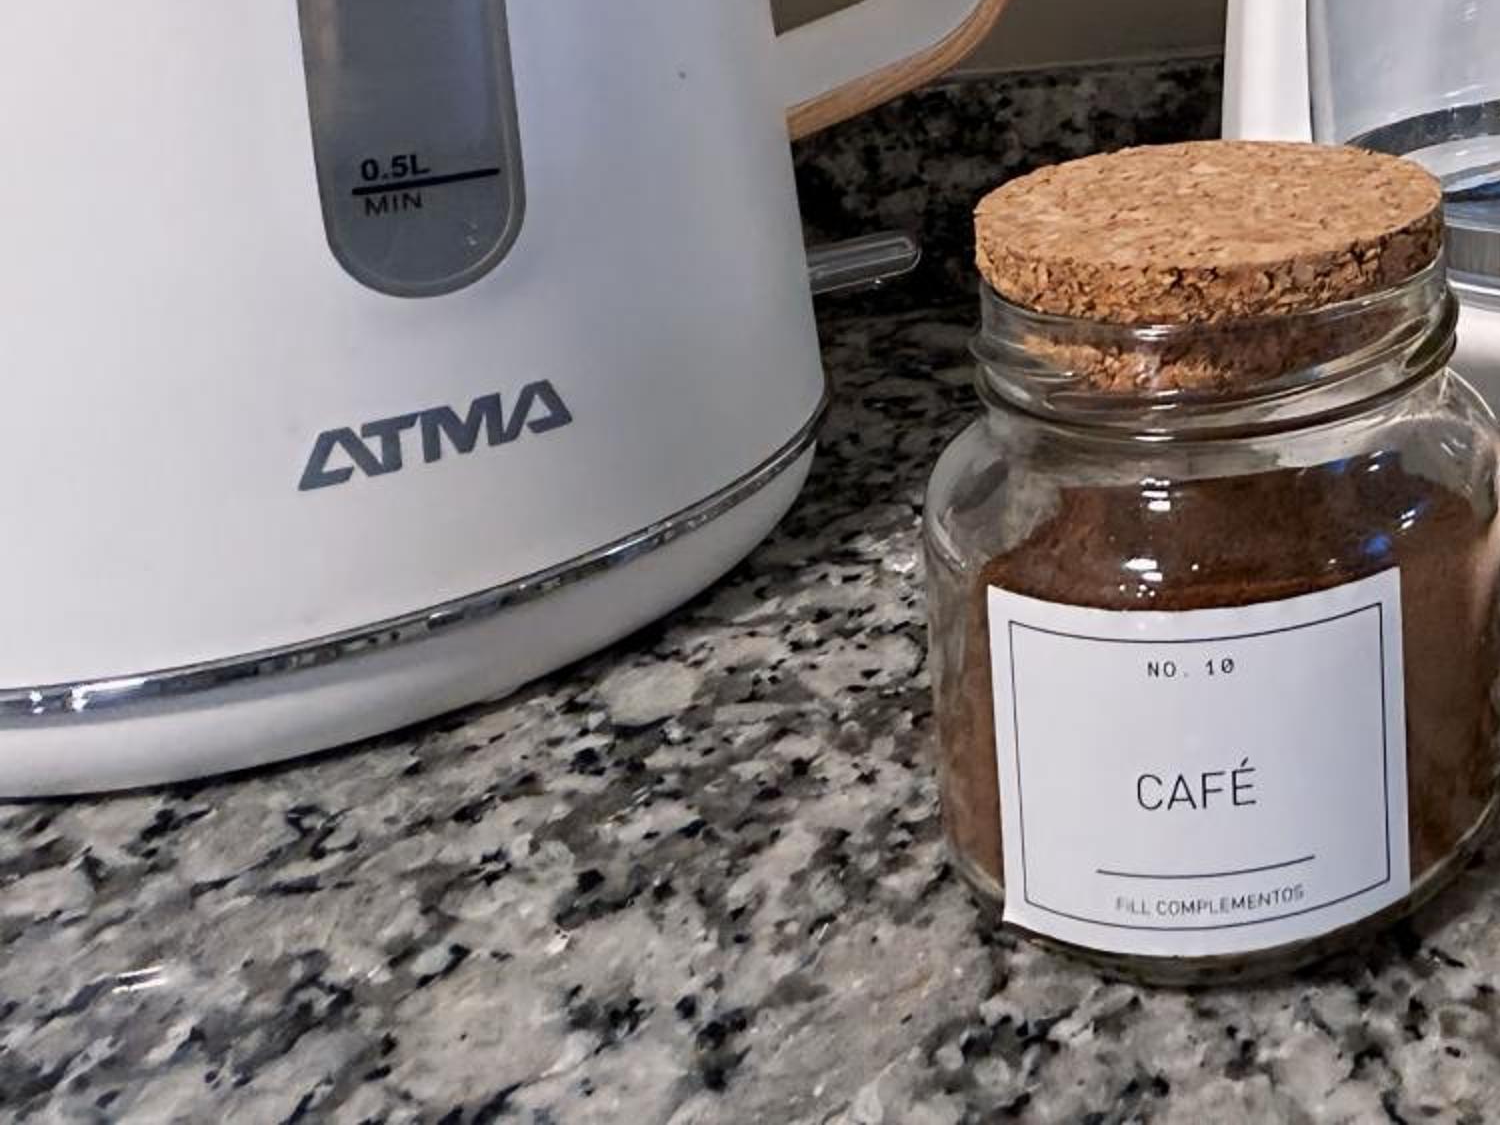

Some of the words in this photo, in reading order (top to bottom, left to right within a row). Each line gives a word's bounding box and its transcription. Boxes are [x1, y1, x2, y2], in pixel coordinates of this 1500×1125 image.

[360, 154, 431, 182] 0.5L
[364, 190, 422, 217] MIN
[298, 379, 573, 491] ATMA
[1147, 660, 1189, 678] NO.
[1205, 658, 1235, 675] 10
[1136, 757, 1257, 811] CAFÉ
[1156, 884, 1305, 916] COMPLEMENTOS
